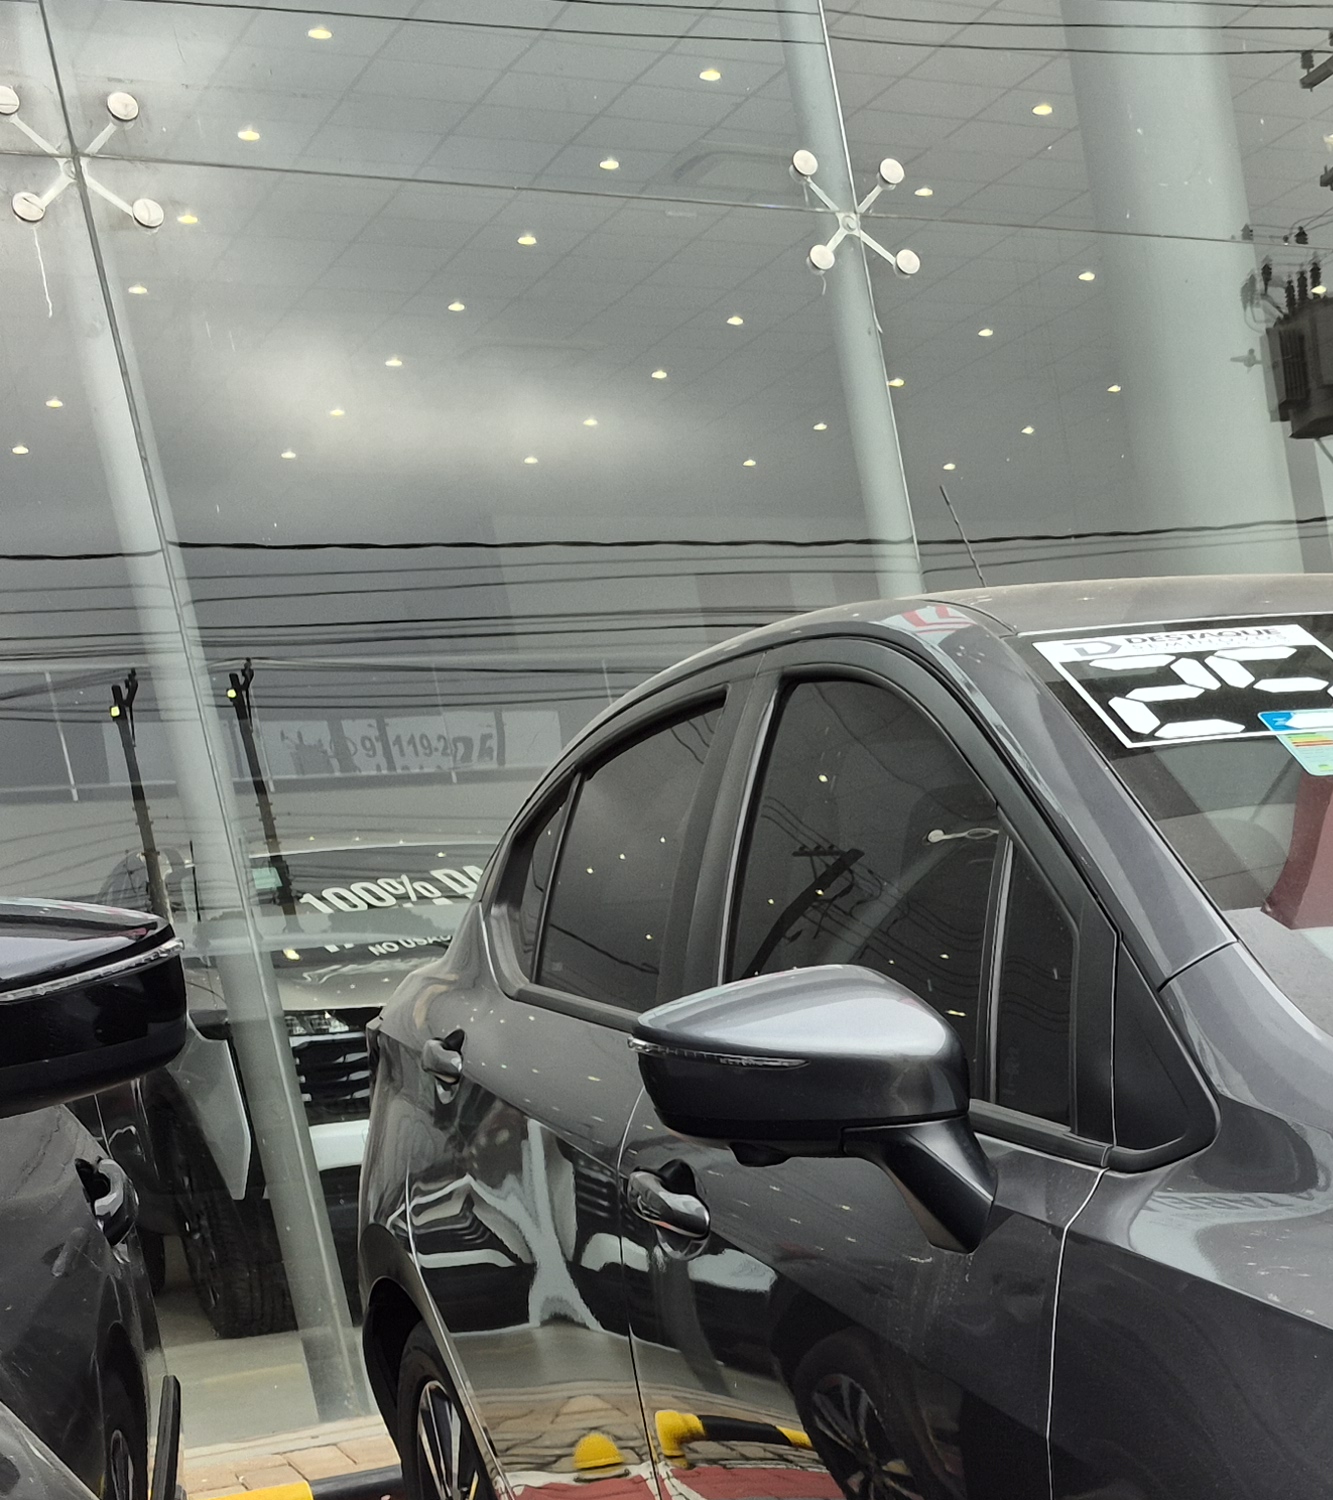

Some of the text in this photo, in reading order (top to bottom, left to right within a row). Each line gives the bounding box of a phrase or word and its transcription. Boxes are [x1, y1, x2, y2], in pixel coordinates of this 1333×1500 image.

[1124, 627, 1282, 645] DESTAQUE
[299, 873, 442, 914] 100%
[368, 942, 400, 956] NO
